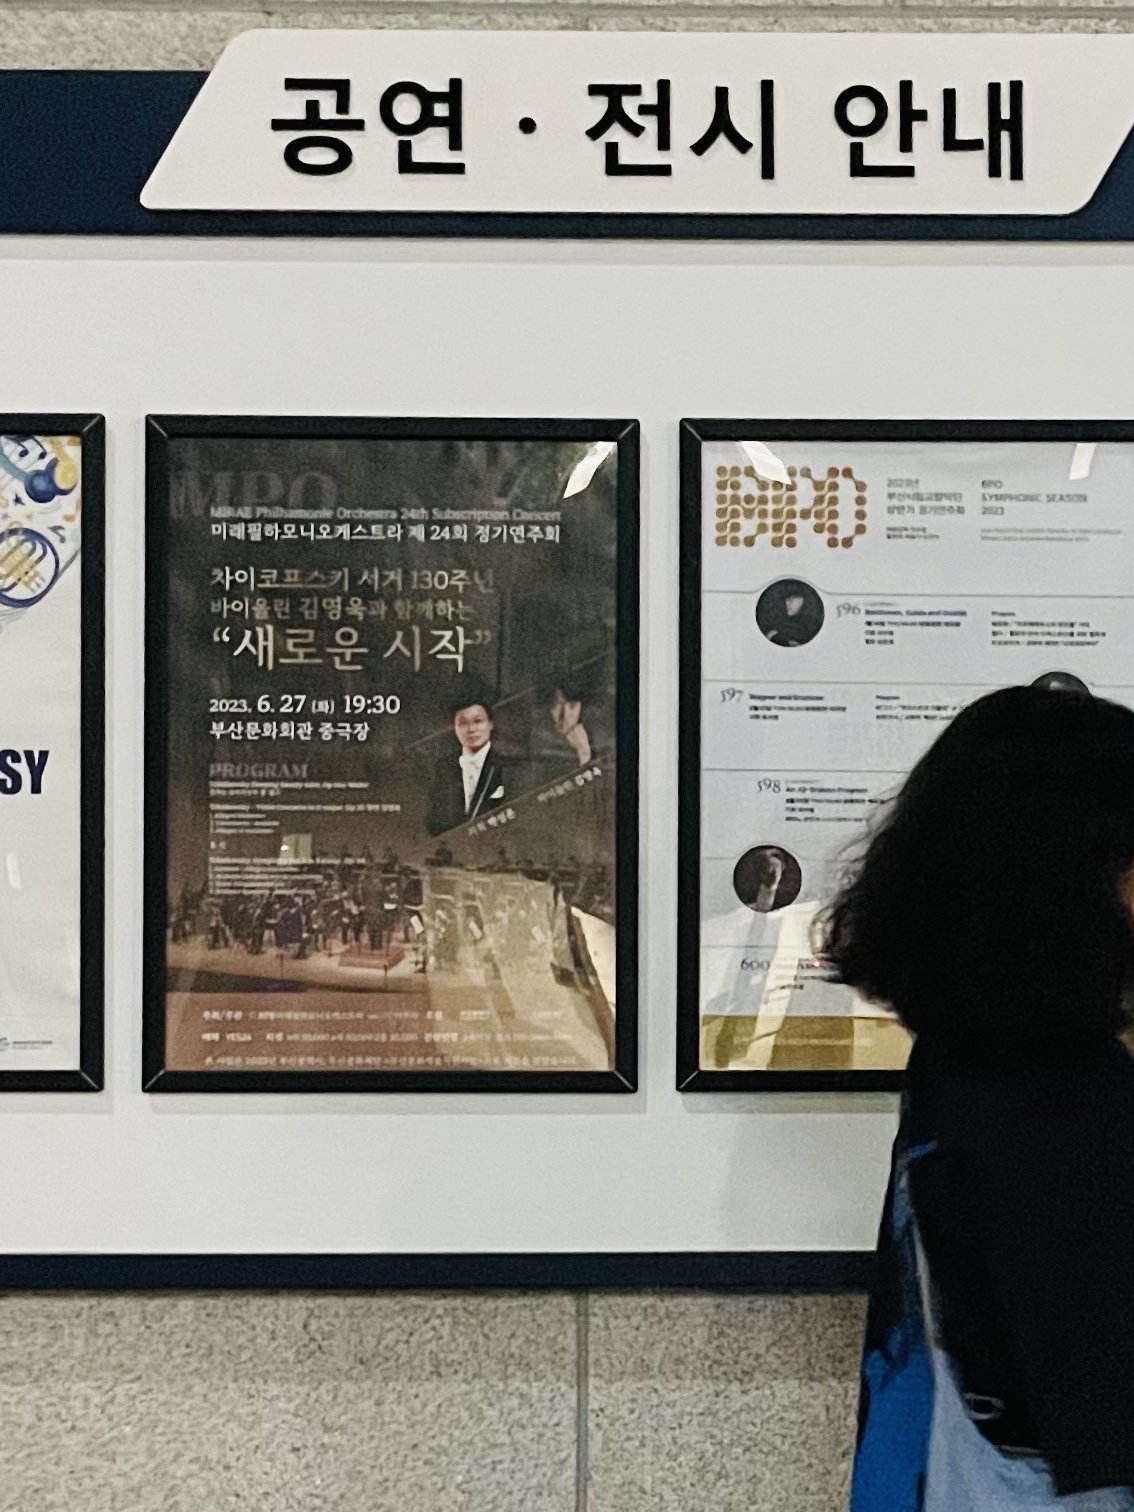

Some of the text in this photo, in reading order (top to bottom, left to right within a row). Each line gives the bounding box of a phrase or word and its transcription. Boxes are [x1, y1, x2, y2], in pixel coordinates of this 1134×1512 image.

[270, 77, 467, 178] 공연
[585, 77, 776, 180] 전시
[832, 78, 1026, 182] 안내
[408, 524, 425, 543] 제
[430, 524, 468, 543] 24회
[474, 524, 560, 543] 정기연주회
[211, 566, 494, 593] 차이코프스키 서거 130주년
[211, 596, 290, 620] 바이올린
[300, 597, 388, 621] 김영욱과
[209, 699, 252, 713] 2023.
[279, 695, 307, 713] 27
[344, 695, 401, 714] 19:30
[209, 721, 371, 742] 부산문화회관 중극장
[209, 762, 308, 778] PROGRAM
